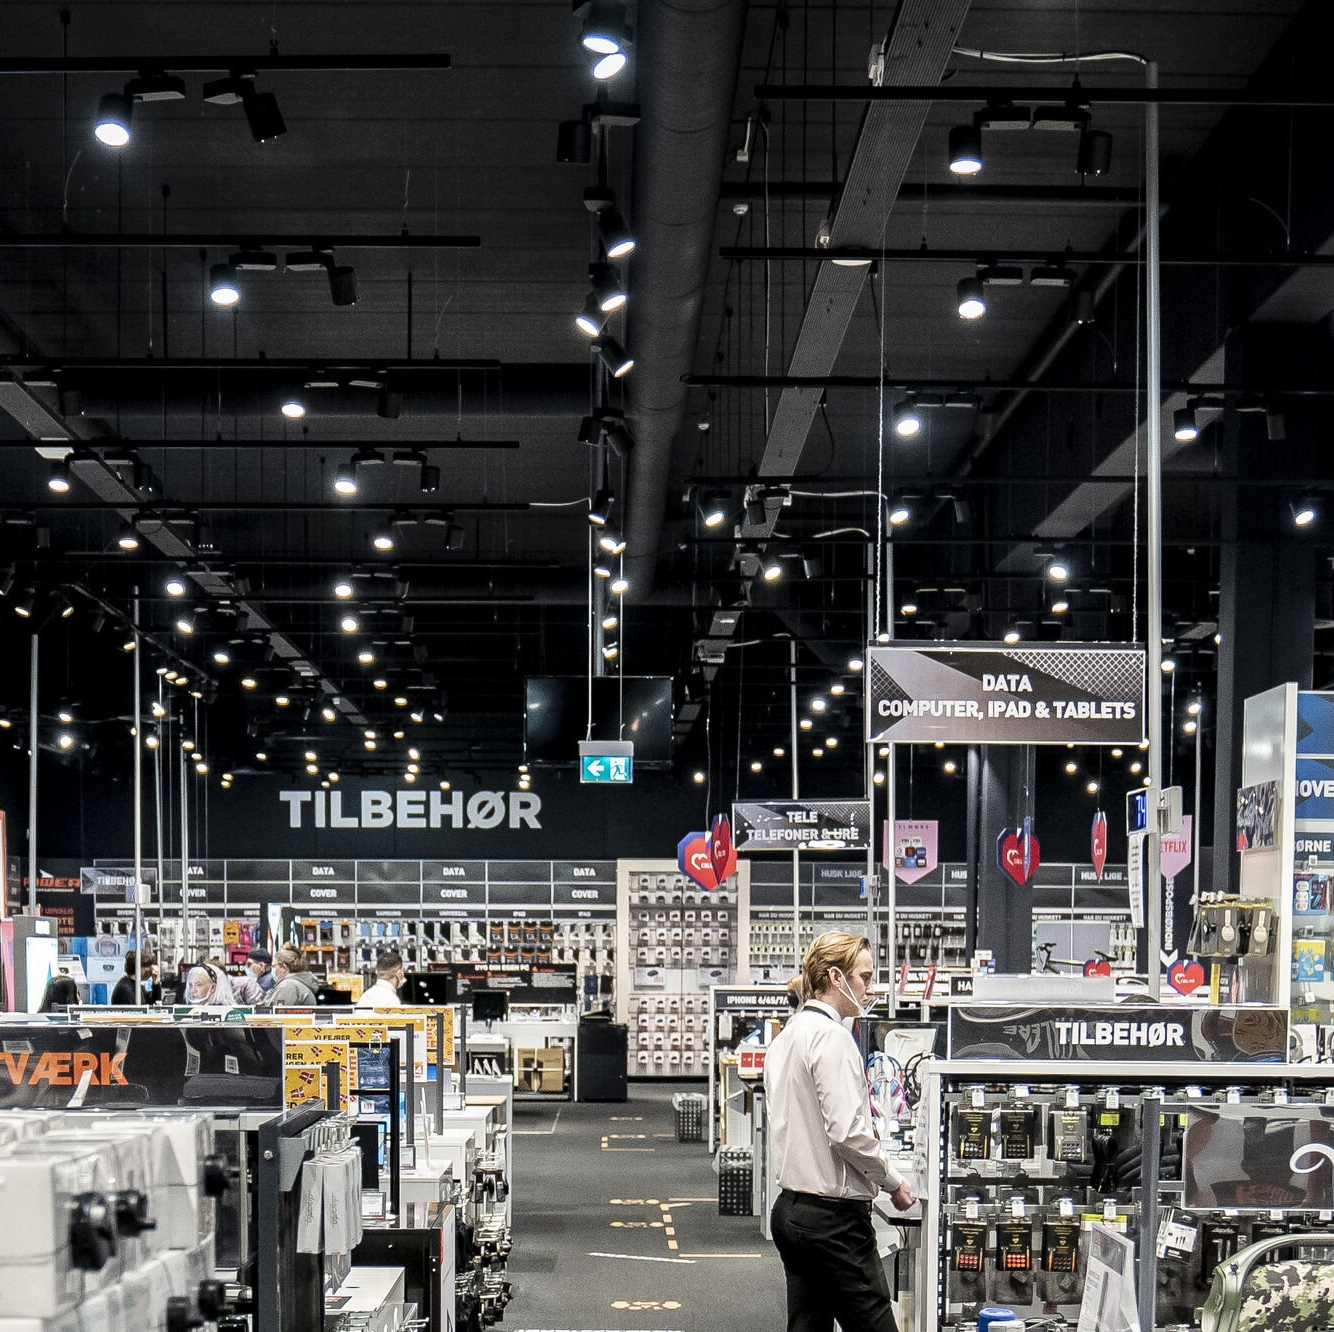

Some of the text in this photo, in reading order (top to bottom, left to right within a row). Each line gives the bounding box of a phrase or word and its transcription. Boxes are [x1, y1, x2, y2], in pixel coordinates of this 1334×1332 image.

[982, 674, 1032, 692] DATA
[878, 699, 1136, 720] COMPUTER, IPAD & TABLETS
[279, 789, 542, 829] TILBEHØR
[786, 811, 818, 823] TELE
[746, 827, 859, 841] TELEFONER & URE
[312, 867, 335, 876] DATA
[442, 867, 465, 876] DATA
[573, 868, 596, 877] DATA
[310, 889, 337, 899] COVER
[440, 889, 467, 899] COVER
[571, 890, 598, 899] COVER
[727, 995, 757, 1005] IPHONE
[1054, 1020, 1184, 1047] TILBEHØR
